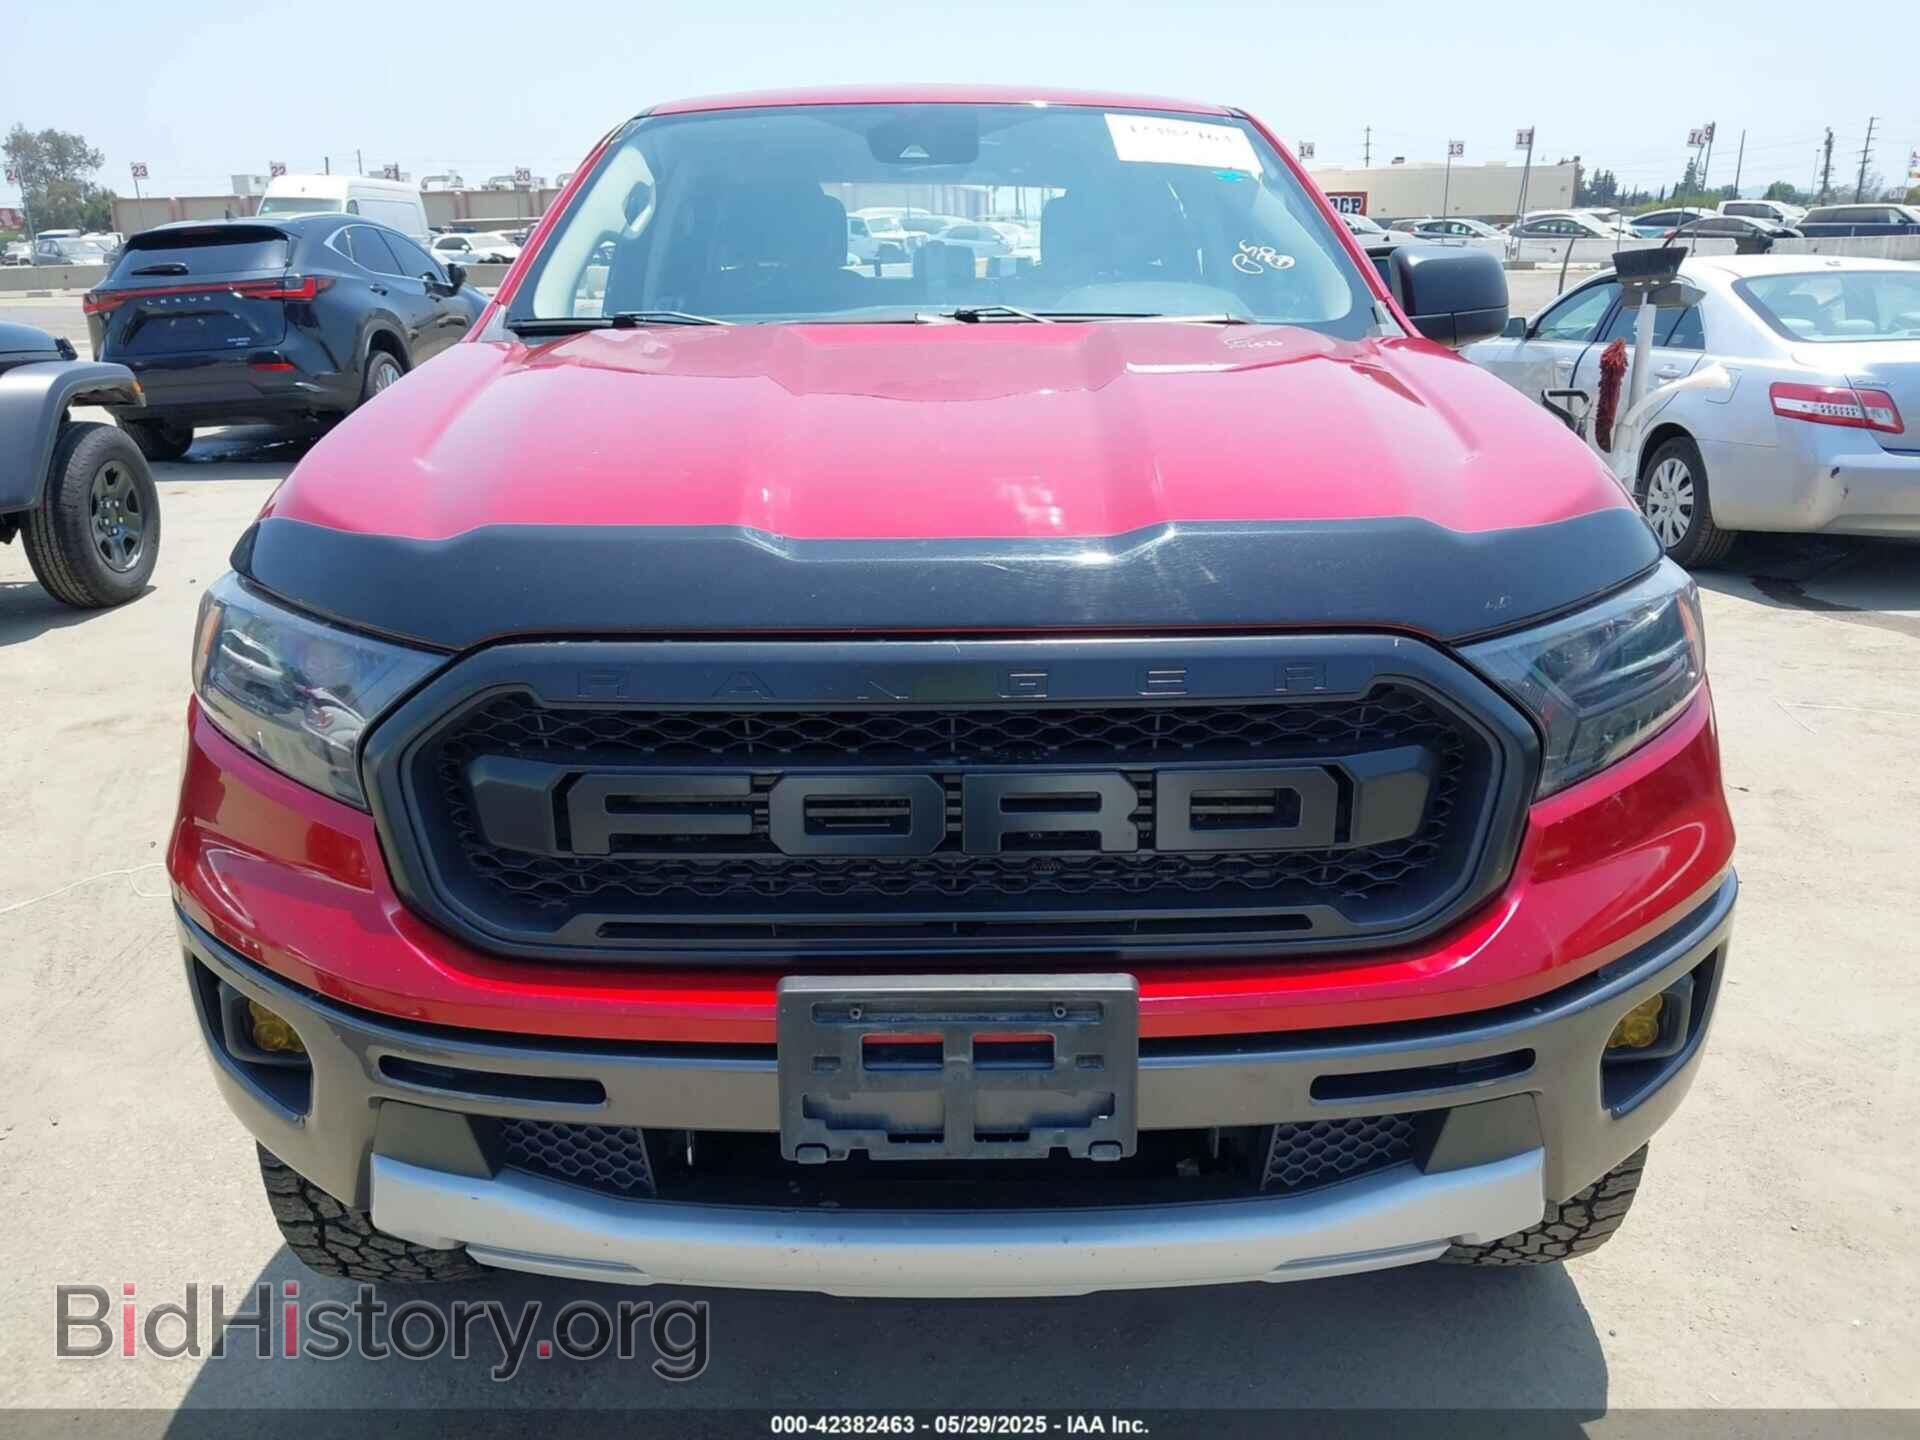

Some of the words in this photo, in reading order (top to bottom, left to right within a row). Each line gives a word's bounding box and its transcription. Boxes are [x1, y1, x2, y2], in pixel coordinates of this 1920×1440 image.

[1300, 146, 1314, 157] 14
[1449, 143, 1464, 155] 13
[131, 165, 148, 177] 23
[271, 166, 287, 177] 22
[515, 169, 530, 181] 20
[576, 665, 1327, 699] RANGER
[566, 766, 1340, 856] FORD
